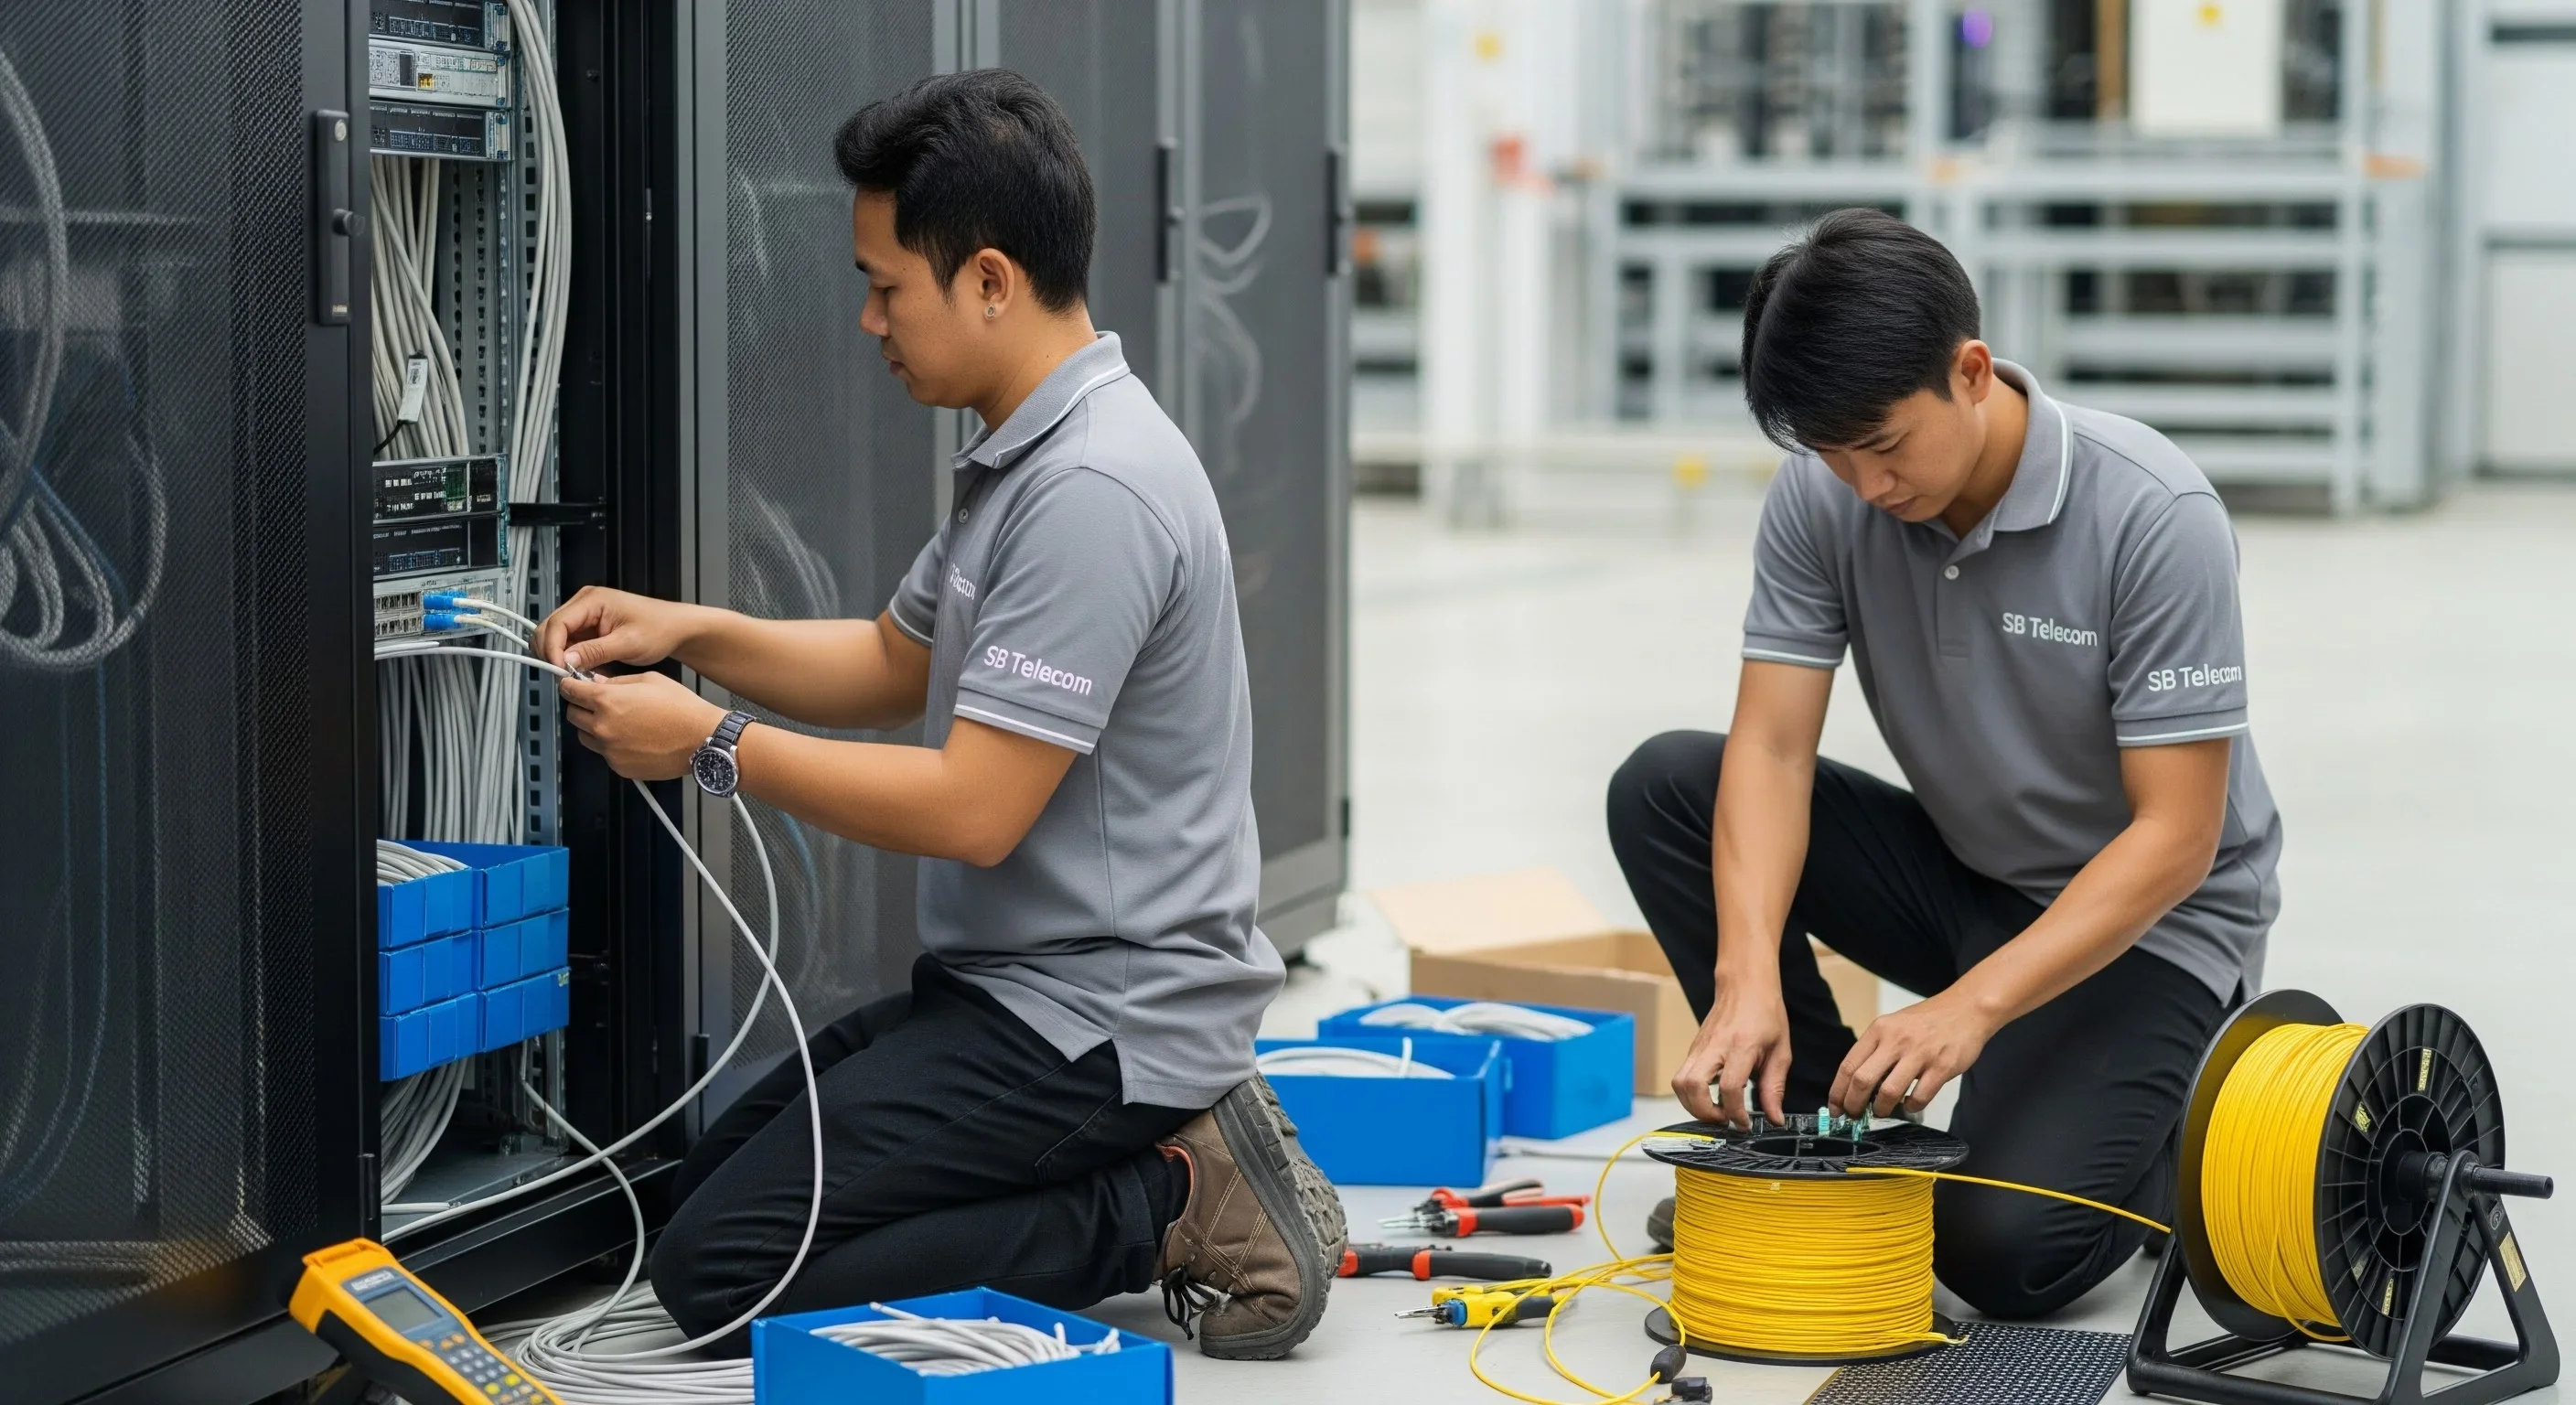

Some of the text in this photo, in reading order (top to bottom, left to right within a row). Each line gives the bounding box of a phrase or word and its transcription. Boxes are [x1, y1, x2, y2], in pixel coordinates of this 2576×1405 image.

[2002, 612, 2098, 647] SB Telecom
[983, 645, 1092, 695] SB Telecom
[2147, 669, 2176, 692] SB
